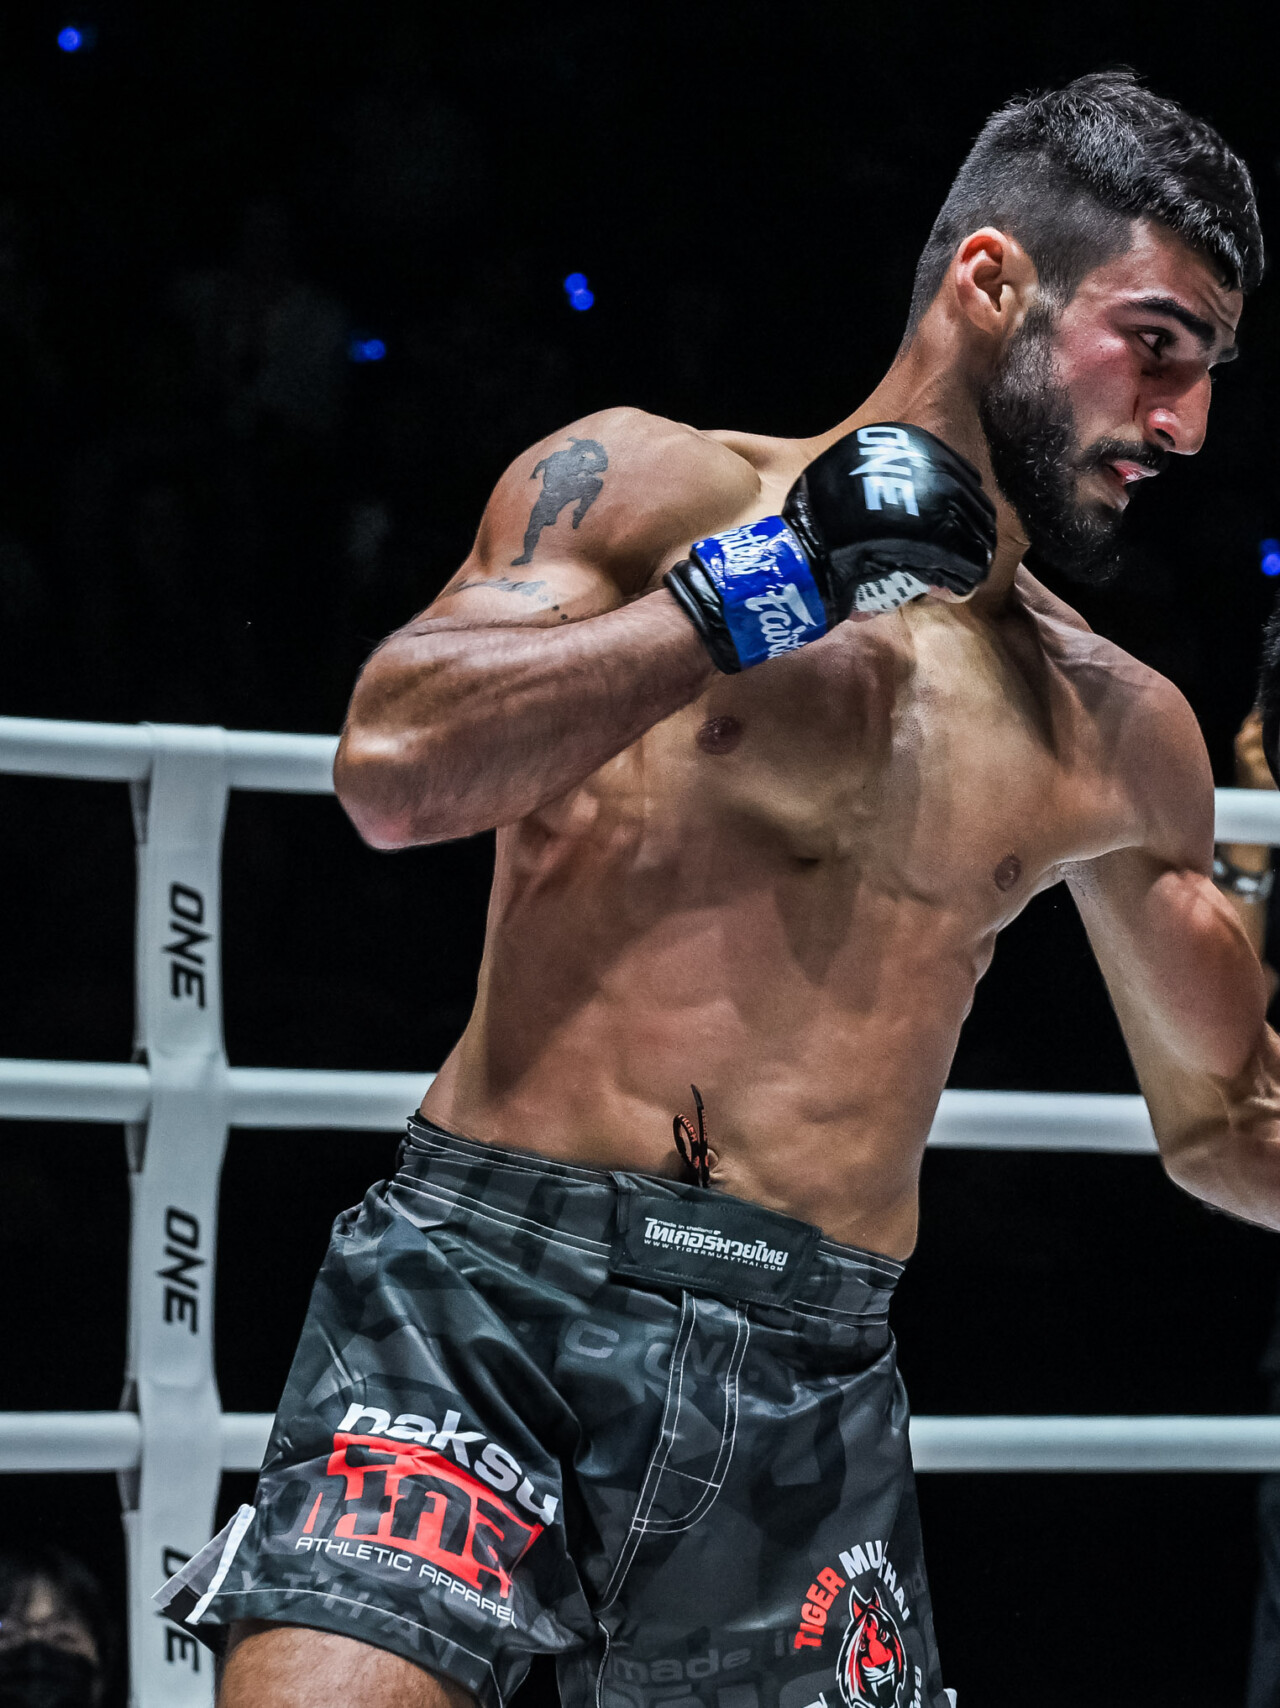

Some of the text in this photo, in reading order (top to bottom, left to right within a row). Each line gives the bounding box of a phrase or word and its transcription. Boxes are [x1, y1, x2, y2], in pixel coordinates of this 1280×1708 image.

[848, 426, 928, 517] ONE
[161, 881, 212, 1009] ONE
[155, 1206, 206, 1335] ONE
[337, 1402, 559, 1526] naksu
[153, 1545, 200, 1673] OE
[295, 1536, 518, 1629] ATHLETIC APPAREL
[794, 1566, 846, 1650] TIGER
